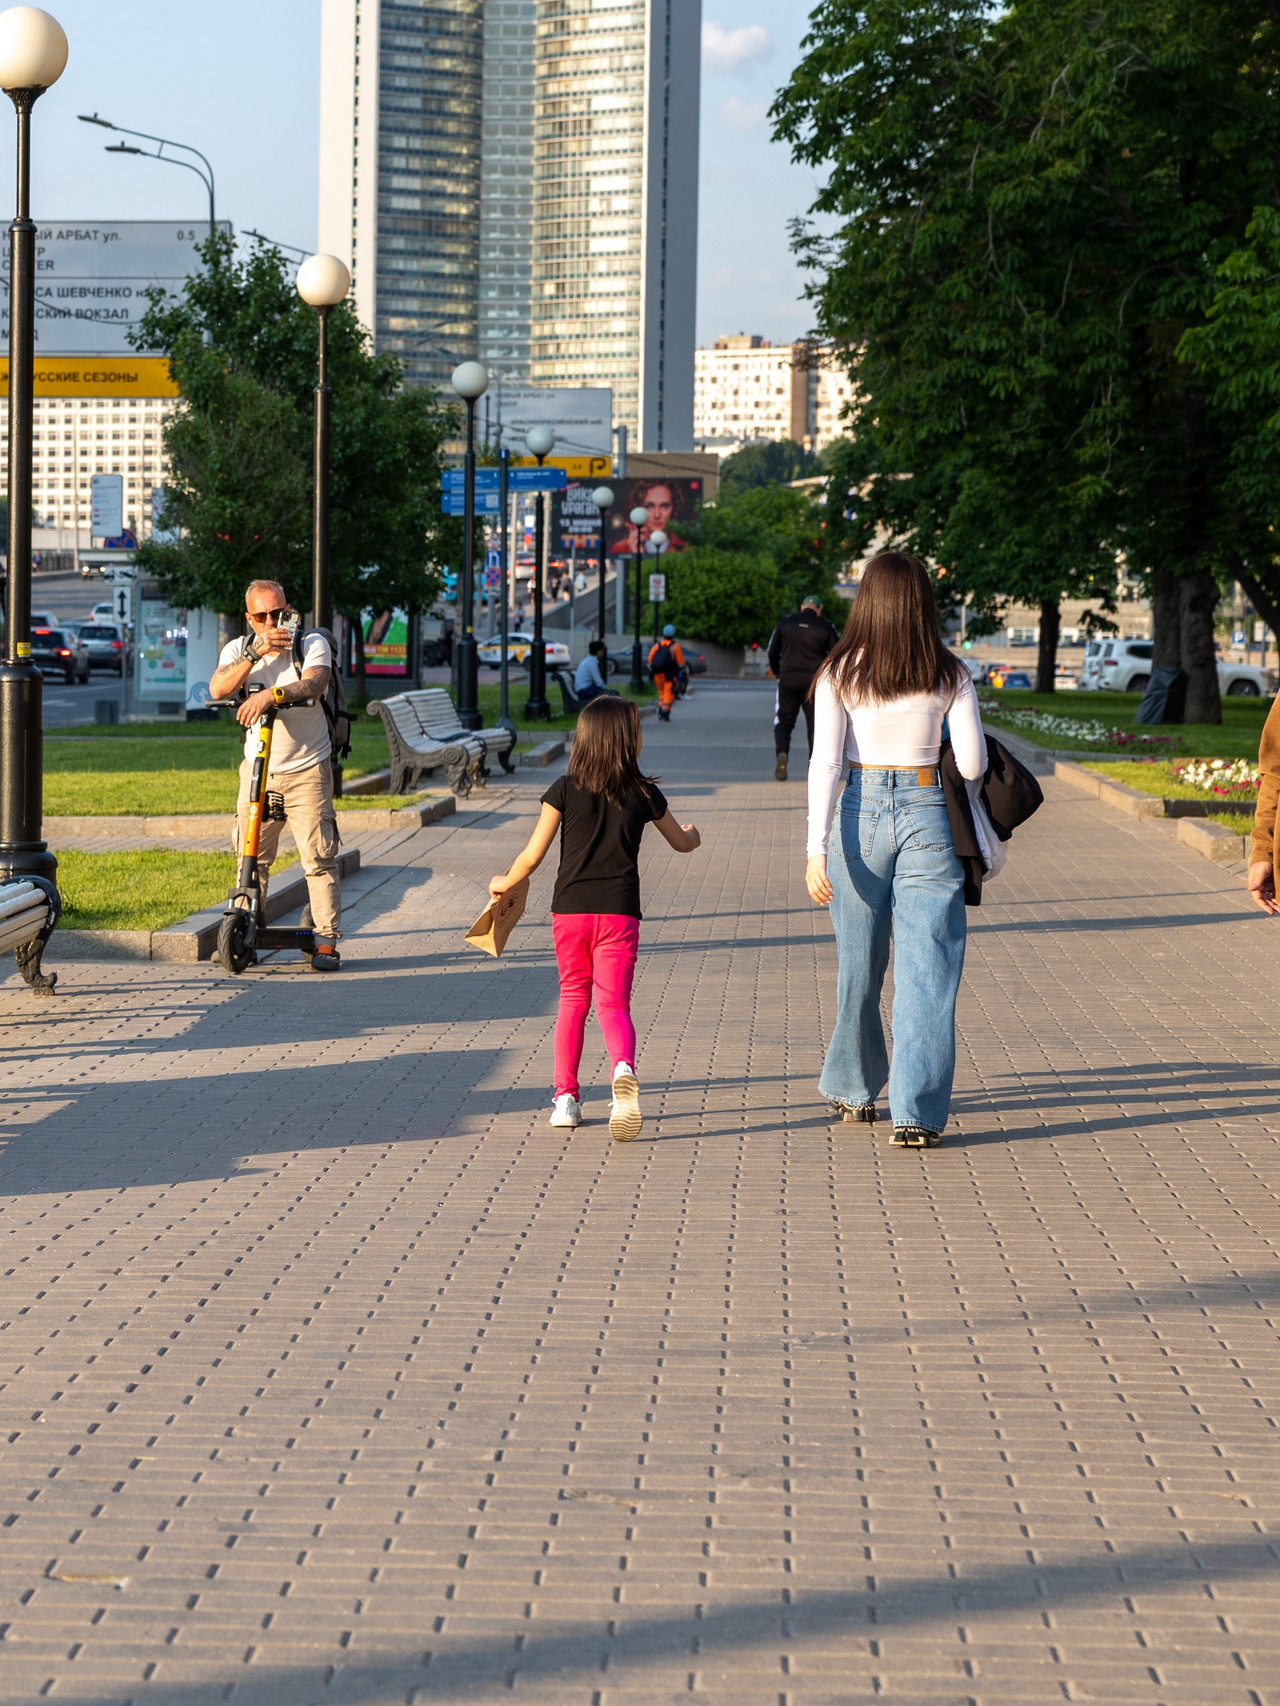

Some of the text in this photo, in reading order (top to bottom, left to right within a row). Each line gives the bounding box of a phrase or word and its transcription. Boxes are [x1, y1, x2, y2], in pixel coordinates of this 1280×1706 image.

[2, 228, 195, 243] НЫЙ АРБАТ ул. 0.5
[57, 287, 133, 298] ШЕВЧЕНКО
[75, 308, 130, 320] ВОКЗАЛ
[83, 371, 139, 383] СЕЗОНЫ
[561, 534, 600, 548] ТНТ
